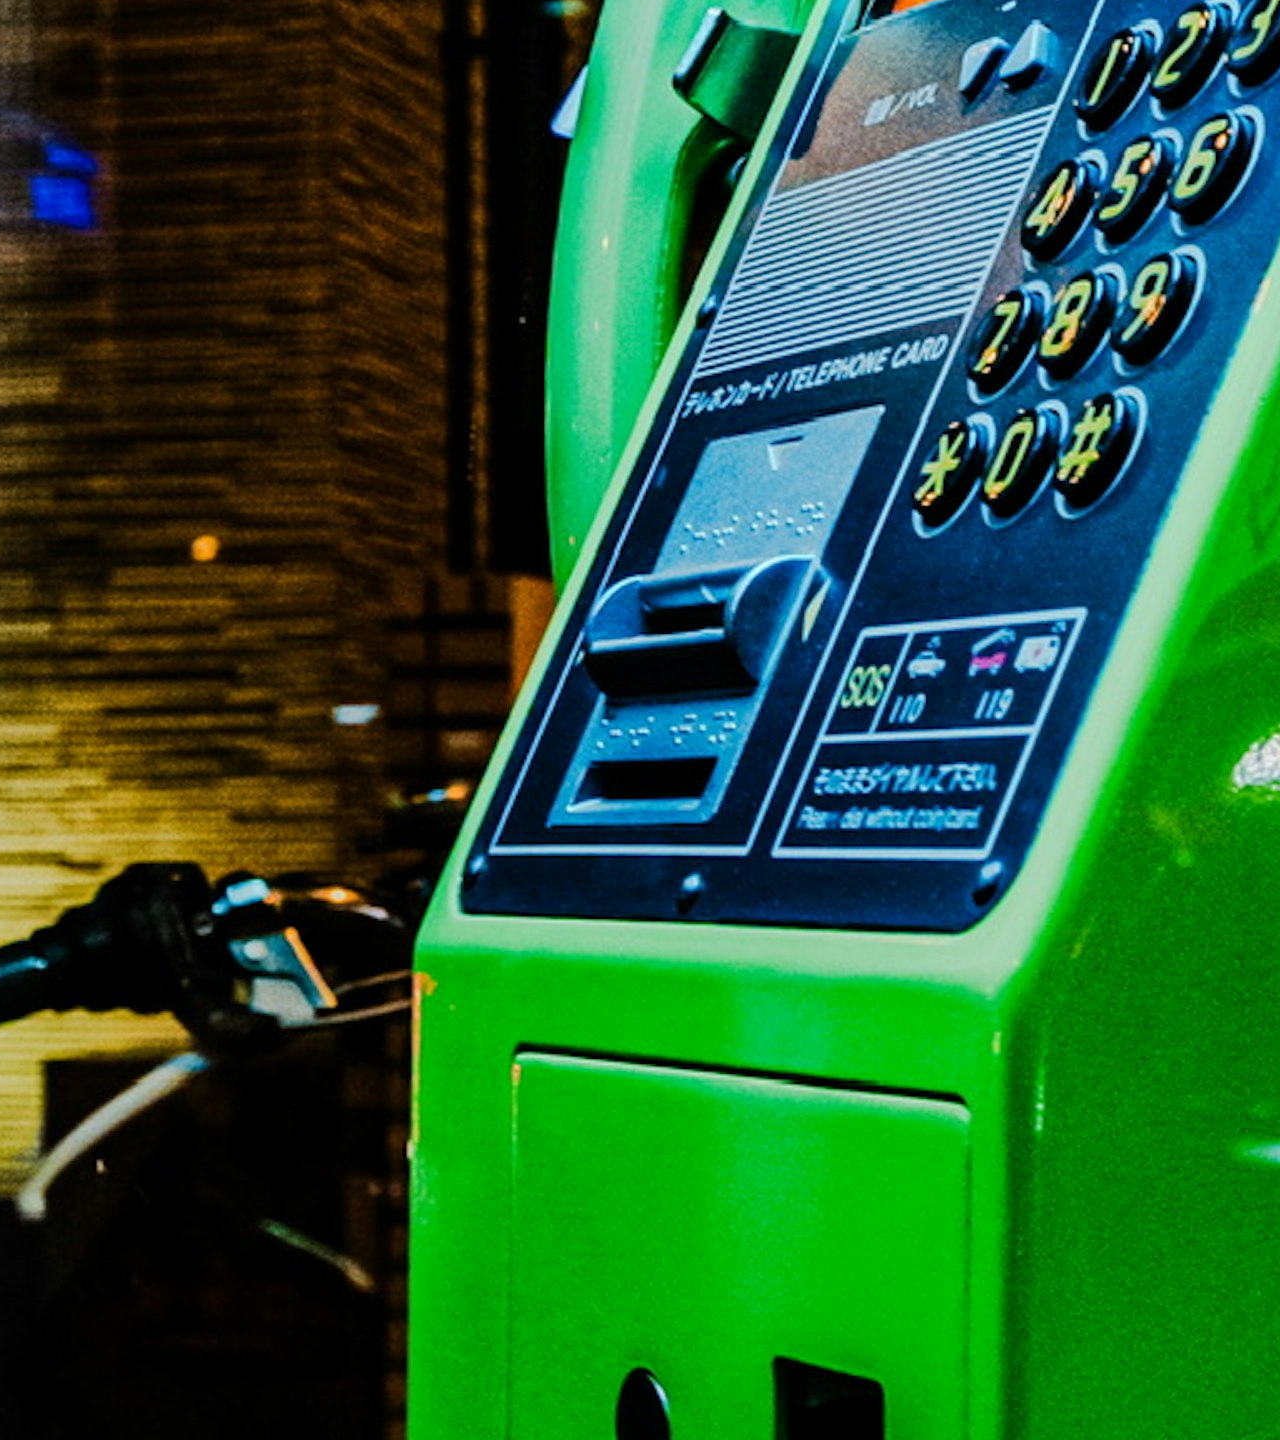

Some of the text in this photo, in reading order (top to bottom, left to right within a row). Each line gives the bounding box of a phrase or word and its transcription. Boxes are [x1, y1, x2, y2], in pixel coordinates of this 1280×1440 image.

[1154, 10, 1210, 89] 2
[1026, 117, 1231, 238] 4 5 6
[890, 332, 950, 369] CARD
[974, 260, 1170, 372] 7 8 9
[983, 420, 1036, 498] 0
[839, 663, 892, 708] SOS
[887, 686, 1015, 725] 110 119
